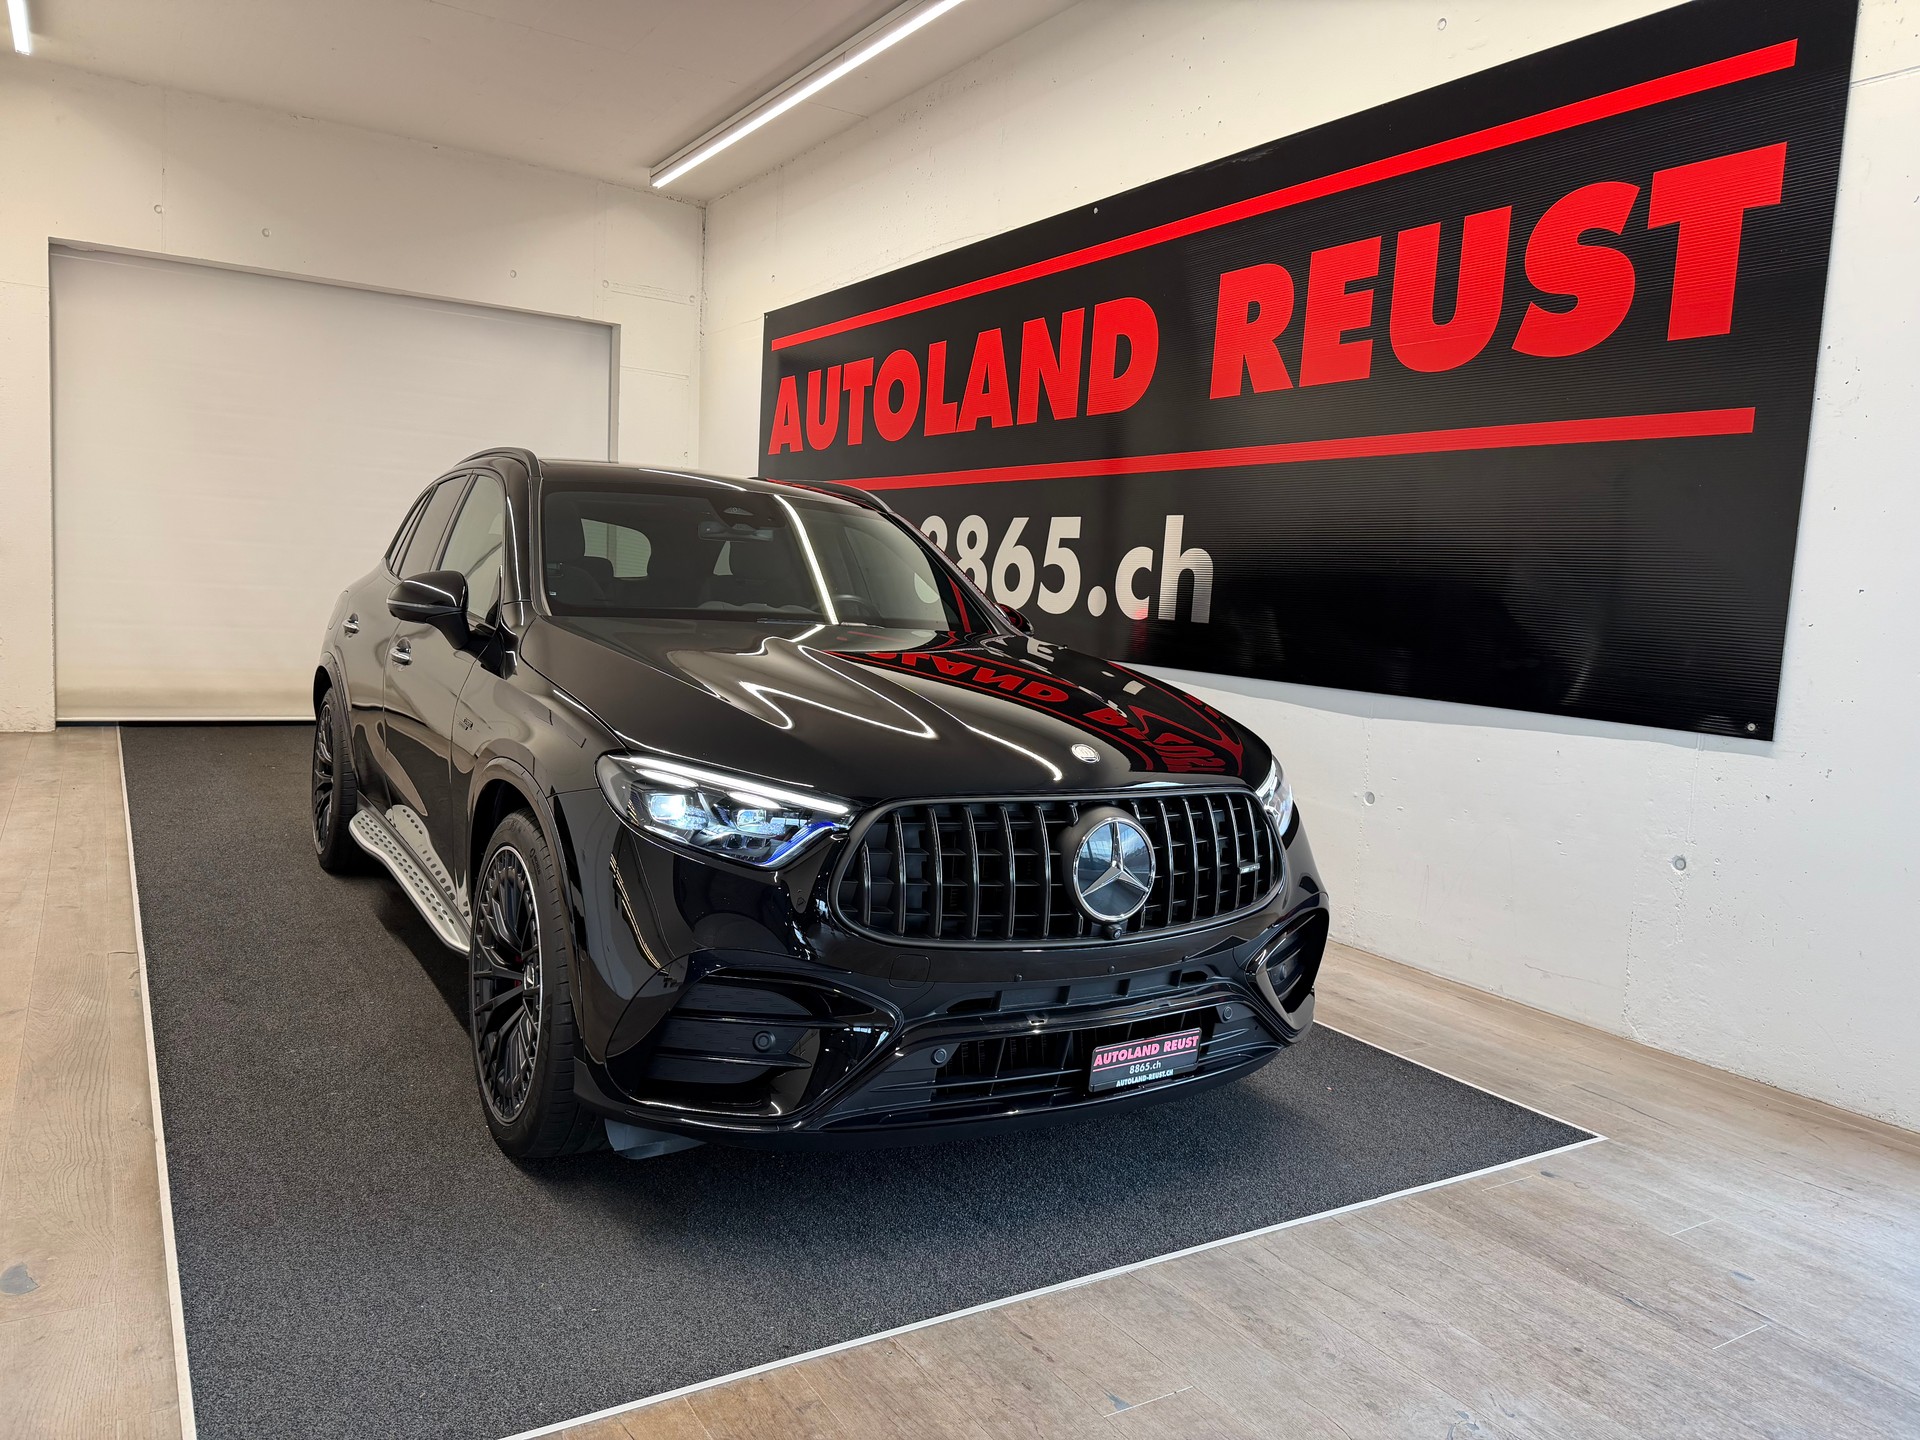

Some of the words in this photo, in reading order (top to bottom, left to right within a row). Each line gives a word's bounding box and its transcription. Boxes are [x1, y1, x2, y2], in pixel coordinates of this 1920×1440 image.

[768, 297, 1160, 456] AUTOLAND
[1210, 142, 1787, 400] REUST
[1093, 1043, 1160, 1067] AUTOLAND
[1163, 1035, 1200, 1053] REUST
[1115, 1069, 1174, 1087] AUTOLAND-REUST.CH
[1129, 1060, 1162, 1075] 8865.ch
